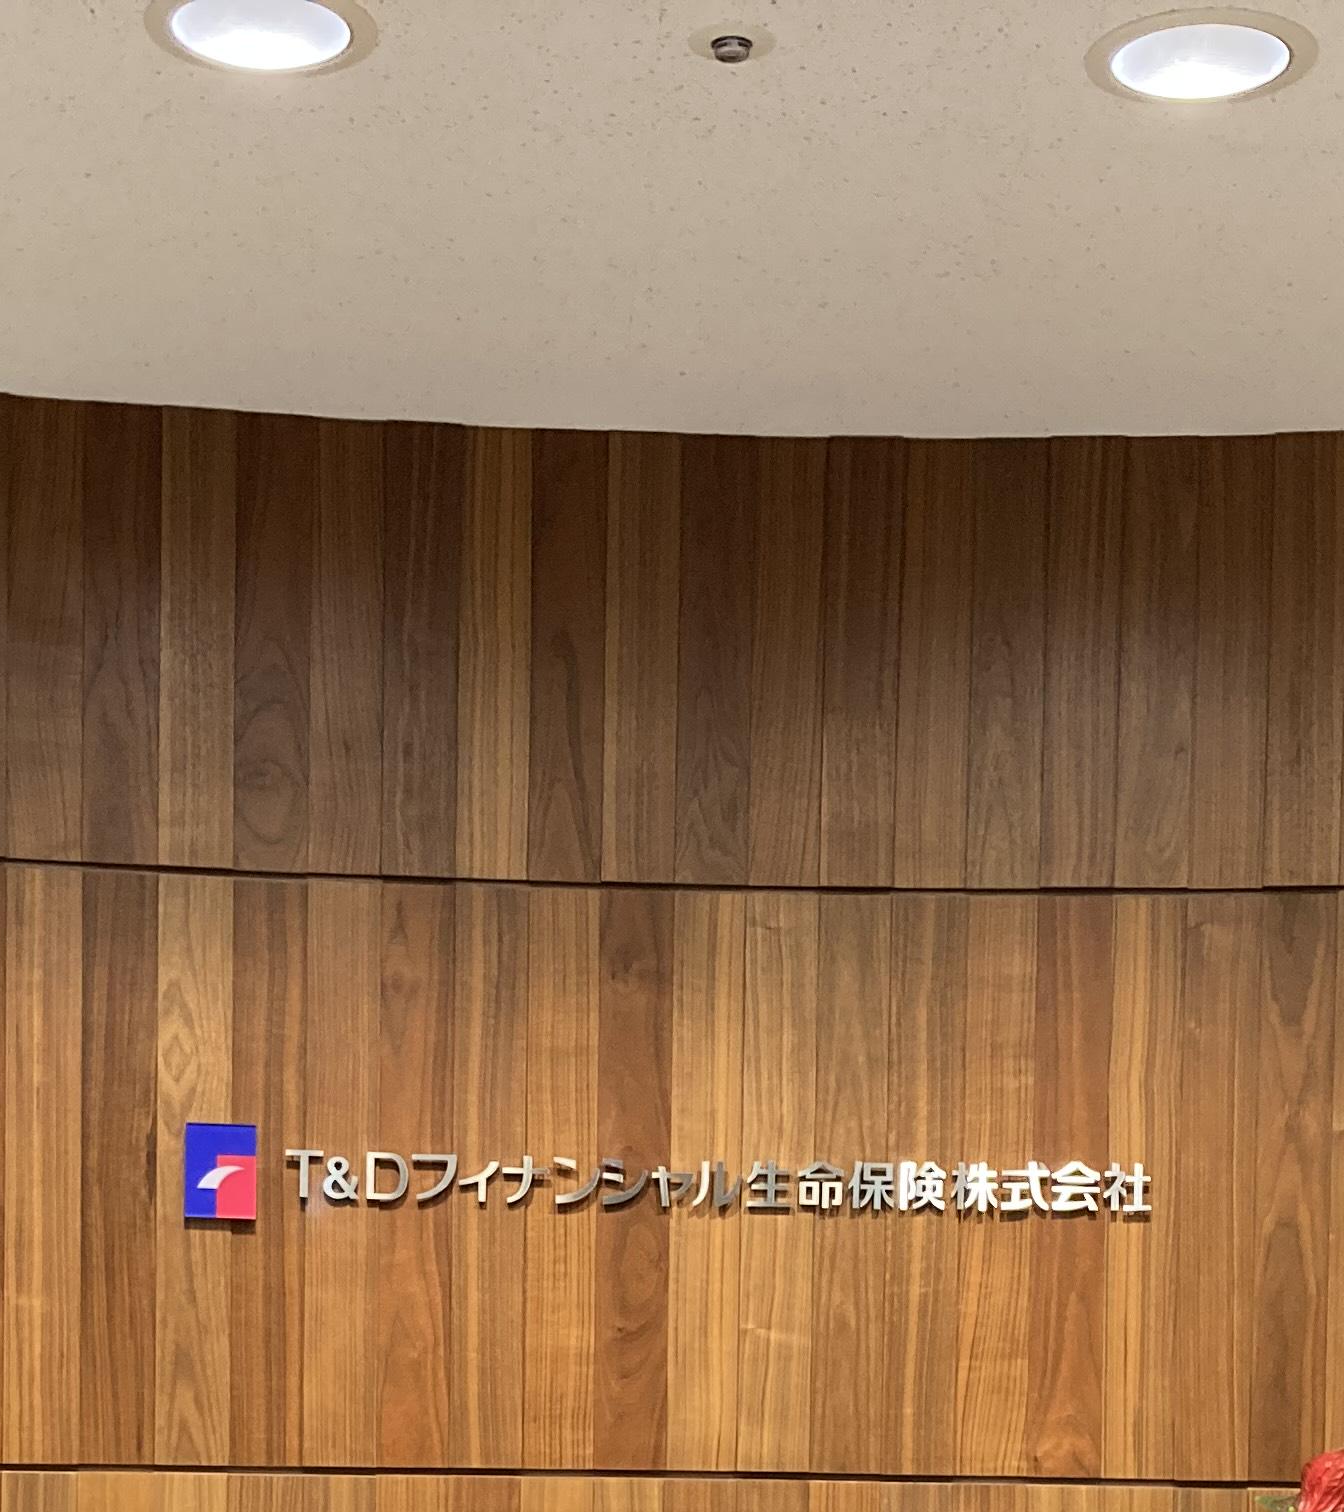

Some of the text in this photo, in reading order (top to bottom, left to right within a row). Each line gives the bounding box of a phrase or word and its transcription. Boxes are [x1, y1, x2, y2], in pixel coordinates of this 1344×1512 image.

[286, 1148, 1152, 1216] T&Dフィナンシャル生命保険株式会社
